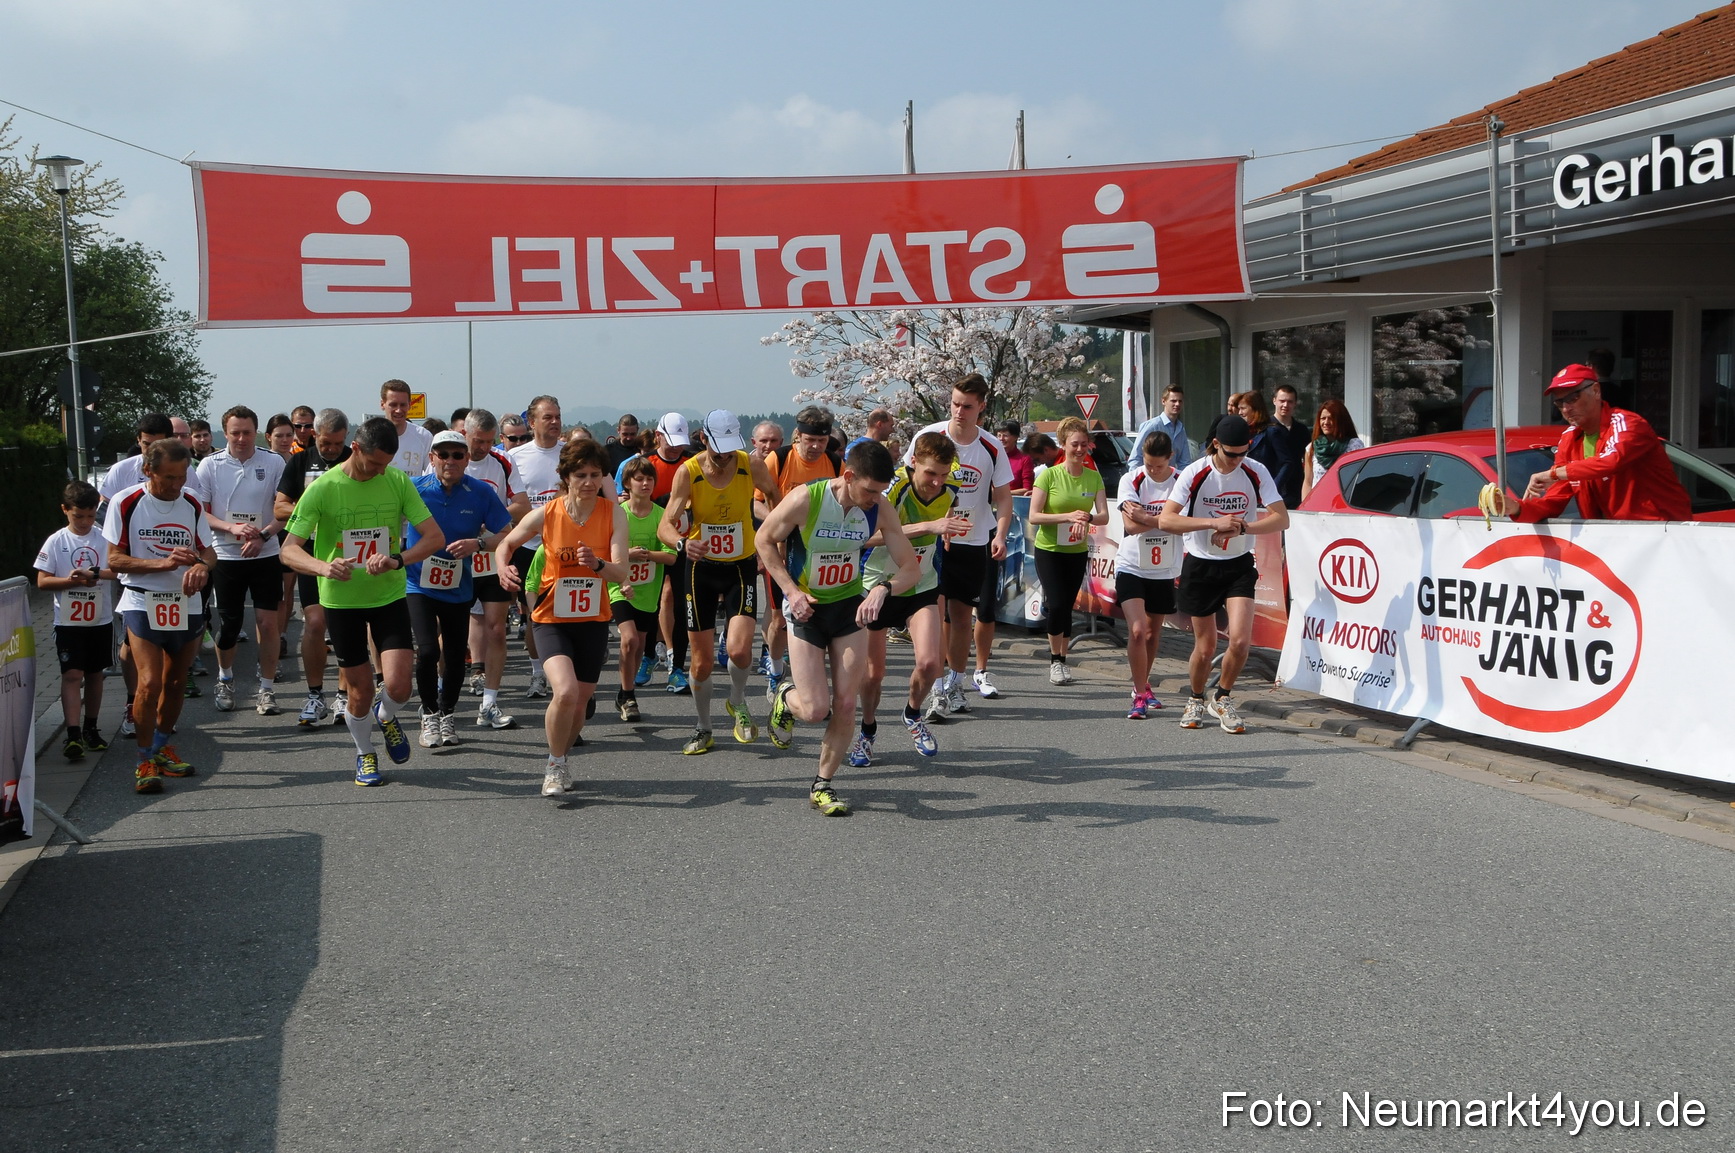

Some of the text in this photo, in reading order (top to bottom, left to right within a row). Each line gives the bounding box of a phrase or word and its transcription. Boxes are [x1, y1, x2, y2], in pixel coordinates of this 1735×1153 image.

[1553, 136, 1735, 209] Gerha
[1202, 496, 1243, 505] GERHART
[138, 528, 186, 538] GERHART
[815, 529, 864, 541] BOCK
[821, 521, 850, 529] TEAM
[354, 540, 377, 564] 74
[710, 534, 735, 554] 93
[430, 557, 449, 565] MEYER
[473, 552, 491, 573] 81
[1151, 546, 1162, 566] 8
[429, 567, 454, 587] 83
[629, 563, 650, 582] 35
[818, 563, 854, 586] 100
[1330, 554, 1370, 591] KIA
[70, 601, 96, 622] 20
[569, 589, 591, 613] 15
[1417, 575, 1613, 634] GERHART &
[155, 603, 181, 627] 66
[1303, 615, 1397, 657] KIA MOTORS
[1420, 624, 1481, 653] AUTOHAUS
[1305, 656, 1316, 672] The
[1479, 629, 1614, 685] JÄNIG
